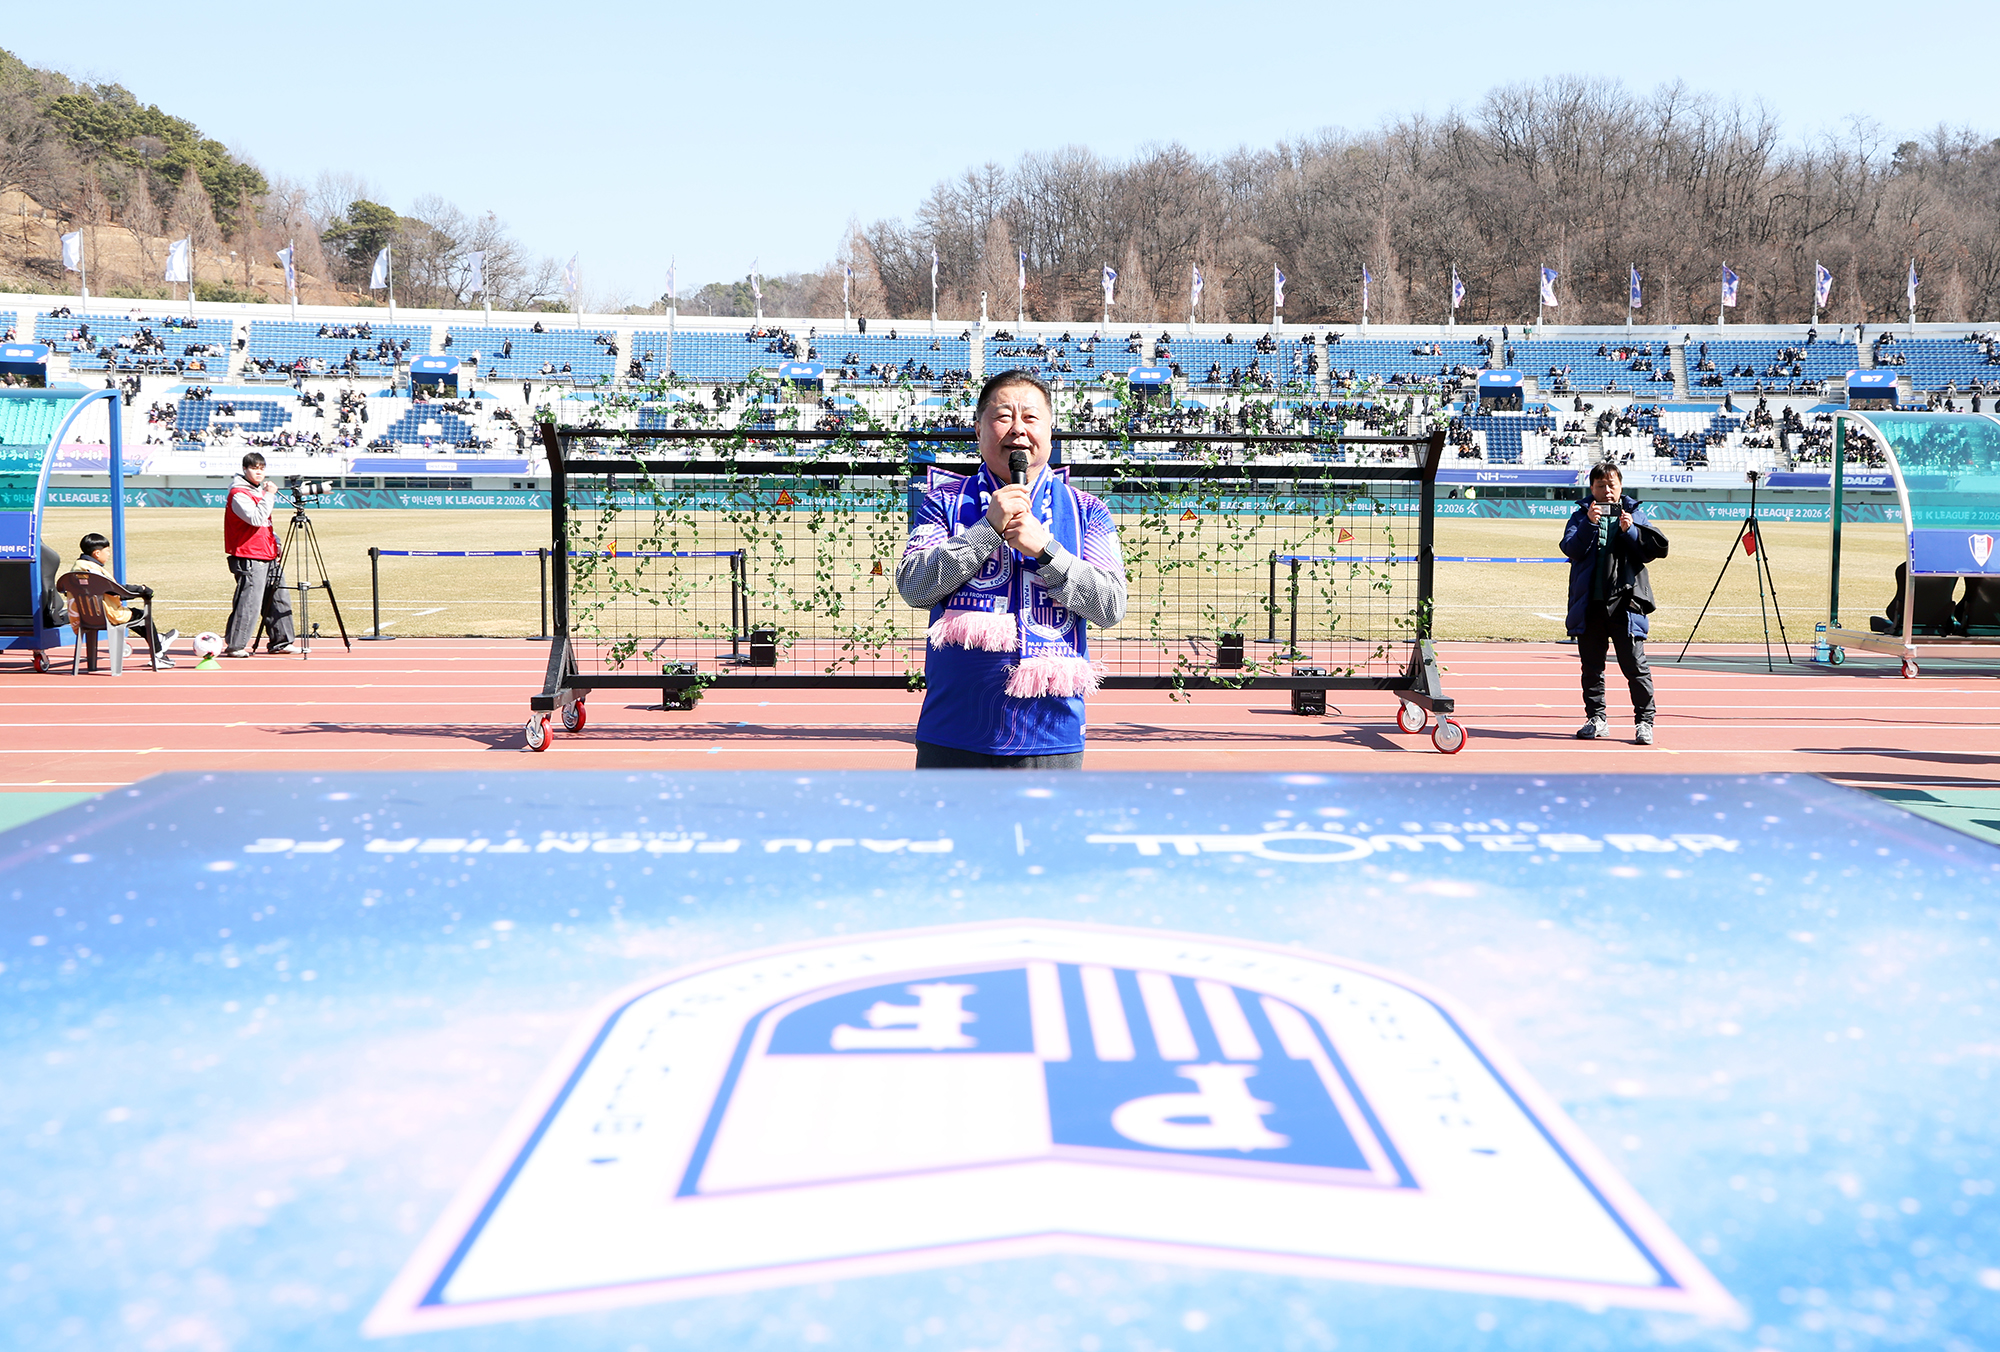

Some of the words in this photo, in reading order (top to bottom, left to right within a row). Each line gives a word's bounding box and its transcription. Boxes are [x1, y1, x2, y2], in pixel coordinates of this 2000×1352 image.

[6, 349, 34, 357] B2
[1476, 472, 1500, 481] NH
[48, 494, 58, 502] K
[60, 494, 101, 503] LEAGUE
[102, 494, 108, 503] 2
[445, 496, 454, 505] K
[455, 496, 496, 505] LEAGUE
[497, 496, 503, 505] 2
[504, 496, 526, 505] 2026
[1437, 504, 1443, 513] 2
[1444, 504, 1465, 513] 2026
[1758, 508, 1794, 517] LEAGUE
[1795, 509, 1802, 518] 2
[1802, 509, 1823, 518] 2026
[1926, 511, 1934, 519] K
[1935, 511, 1970, 520] LEAGUE
[1971, 511, 1977, 520] 2
[16, 545, 27, 553] FC
[986, 560, 996, 575] F
[1038, 591, 1048, 606] P
[1056, 609, 1064, 623] F
[242, 837, 345, 854] FC
[365, 837, 742, 854] FRONTIER
[764, 837, 955, 854] PAJU
[830, 982, 978, 1051] F
[1112, 1062, 1293, 1151] P
